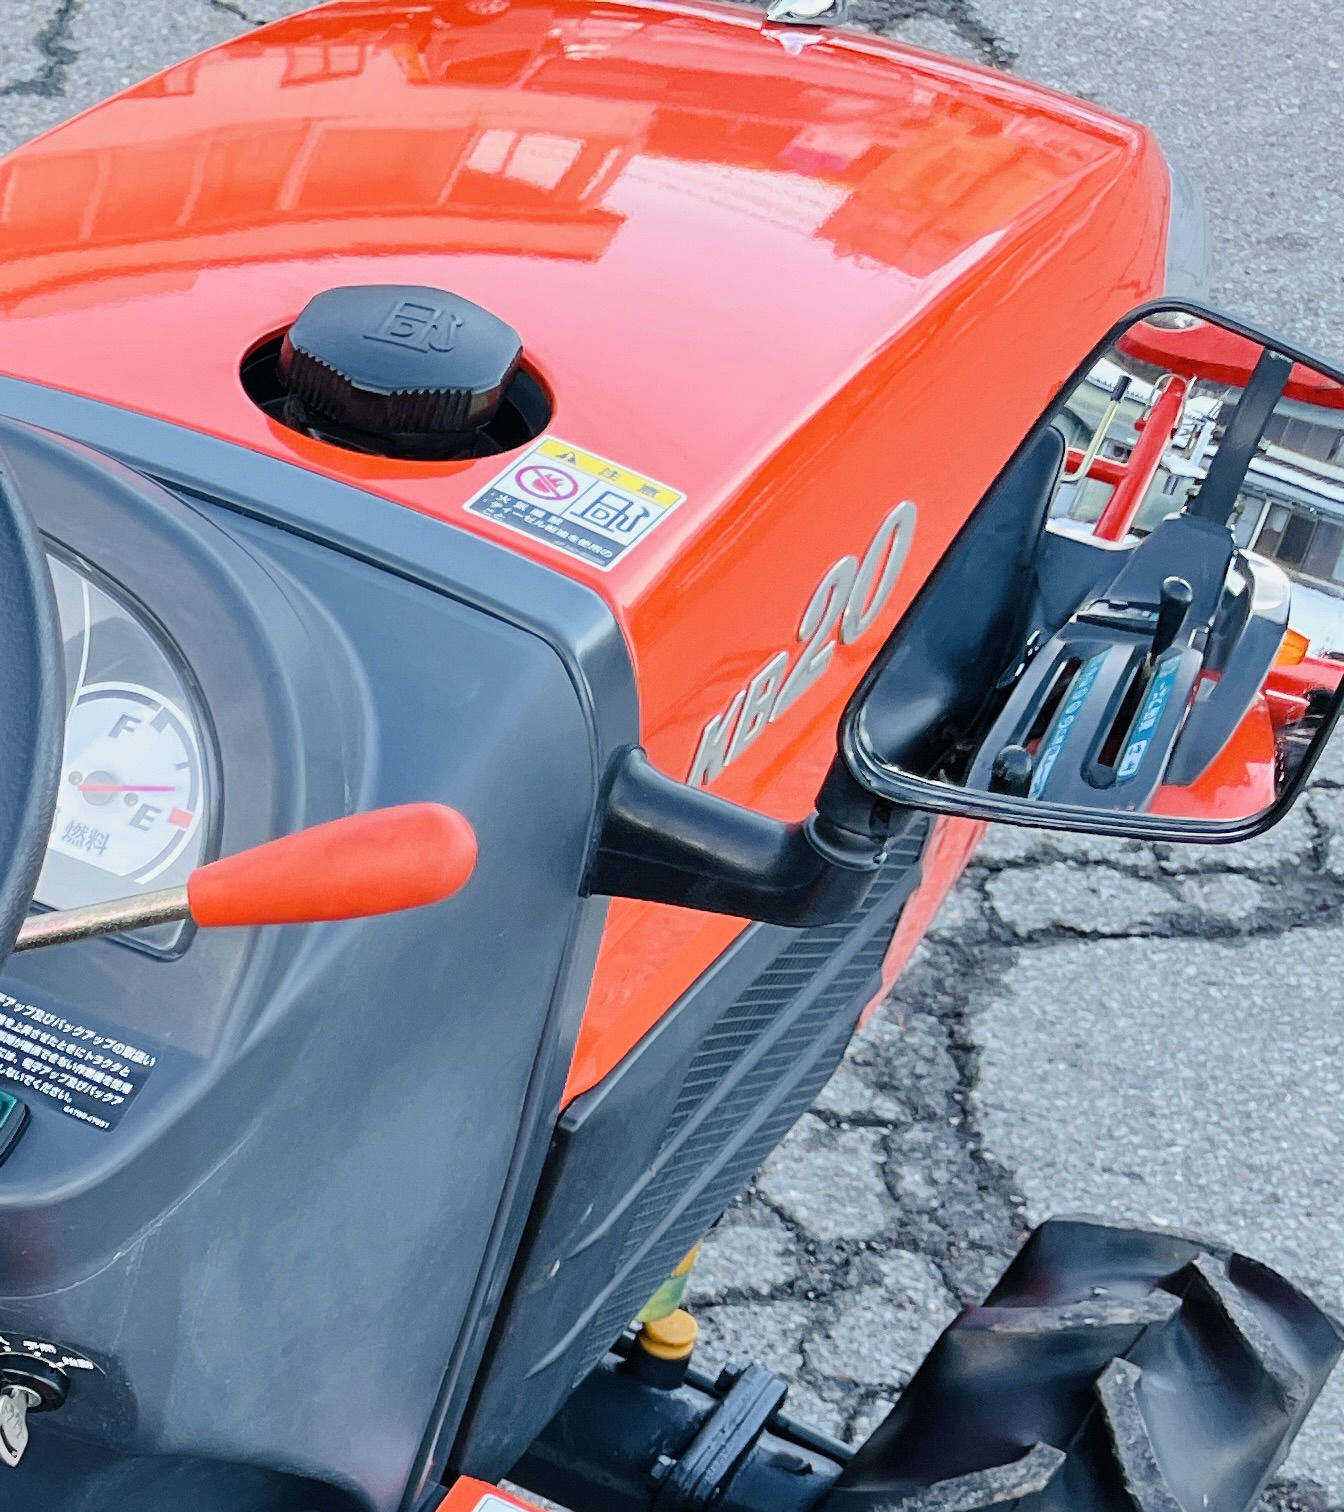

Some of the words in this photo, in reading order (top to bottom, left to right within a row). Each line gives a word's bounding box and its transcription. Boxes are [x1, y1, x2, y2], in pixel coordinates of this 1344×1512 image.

[108, 713, 142, 740] F
[128, 802, 163, 832] E
[62, 819, 111, 856] 燃料
